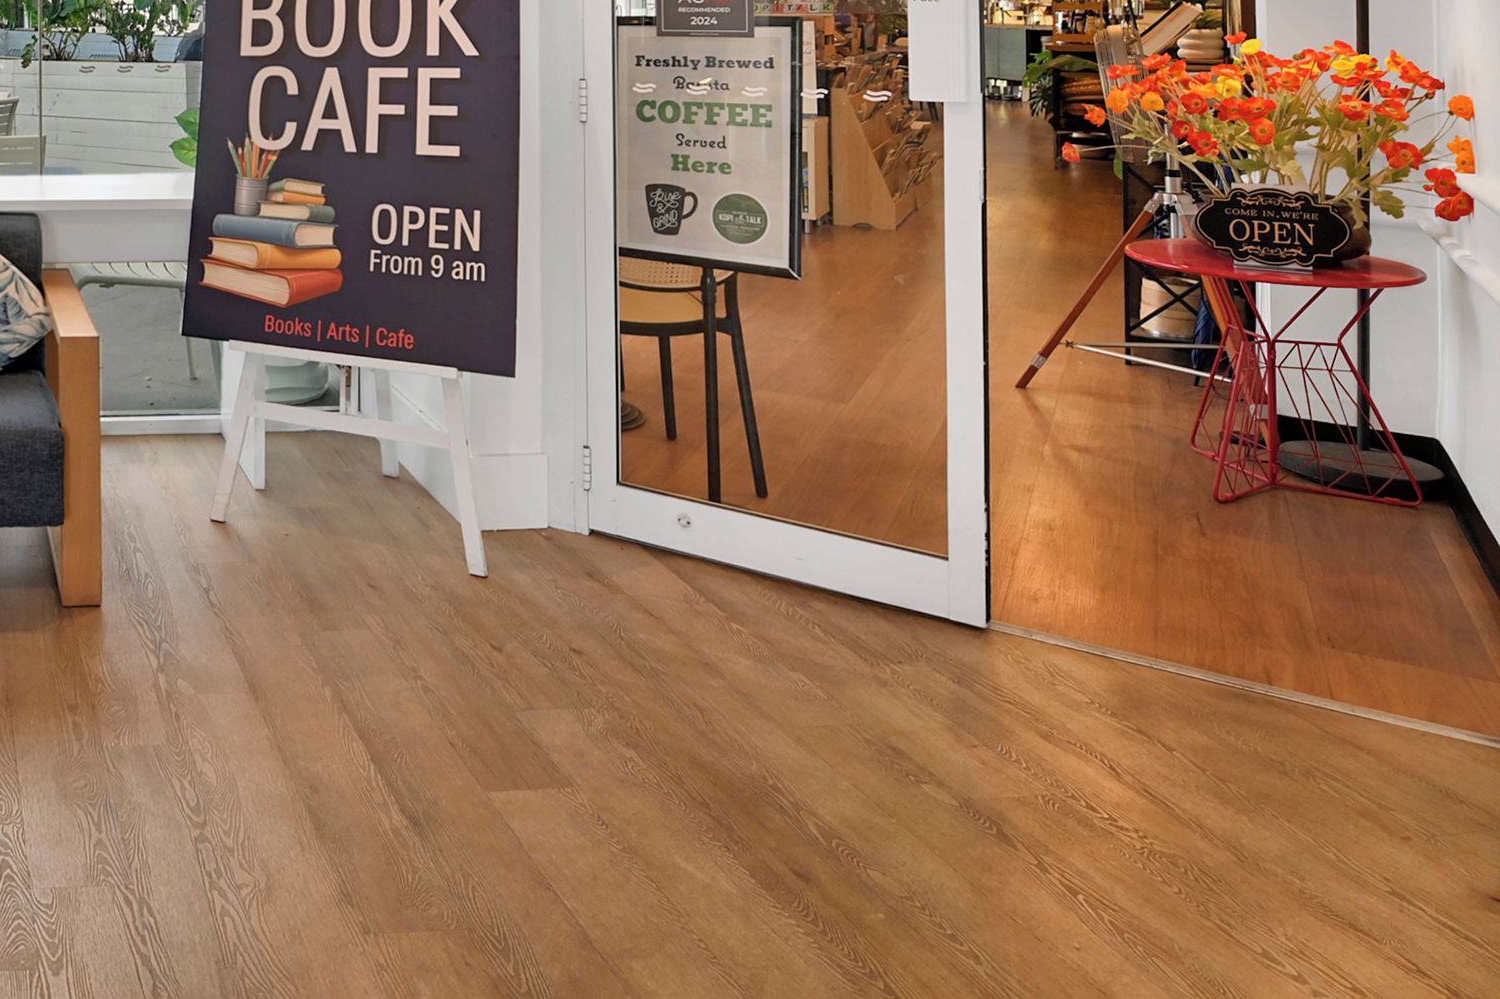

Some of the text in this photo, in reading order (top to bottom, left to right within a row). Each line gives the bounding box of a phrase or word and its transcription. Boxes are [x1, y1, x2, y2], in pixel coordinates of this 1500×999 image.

[690, 16, 718, 26] 2024
[635, 55, 775, 70] Freshly Brewed
[248, 66, 461, 157] CAFE
[636, 100, 772, 128] COFFEE
[676, 133, 727, 149] Served
[671, 154, 732, 175] Here
[1224, 208, 1258, 217] COME
[371, 204, 482, 252] OPEN
[1228, 218, 1315, 246] OPEN
[369, 250, 486, 283] From 9 am
[264, 314, 312, 339] Books
[326, 321, 360, 344] Arts
[376, 326, 414, 351] Cafe
